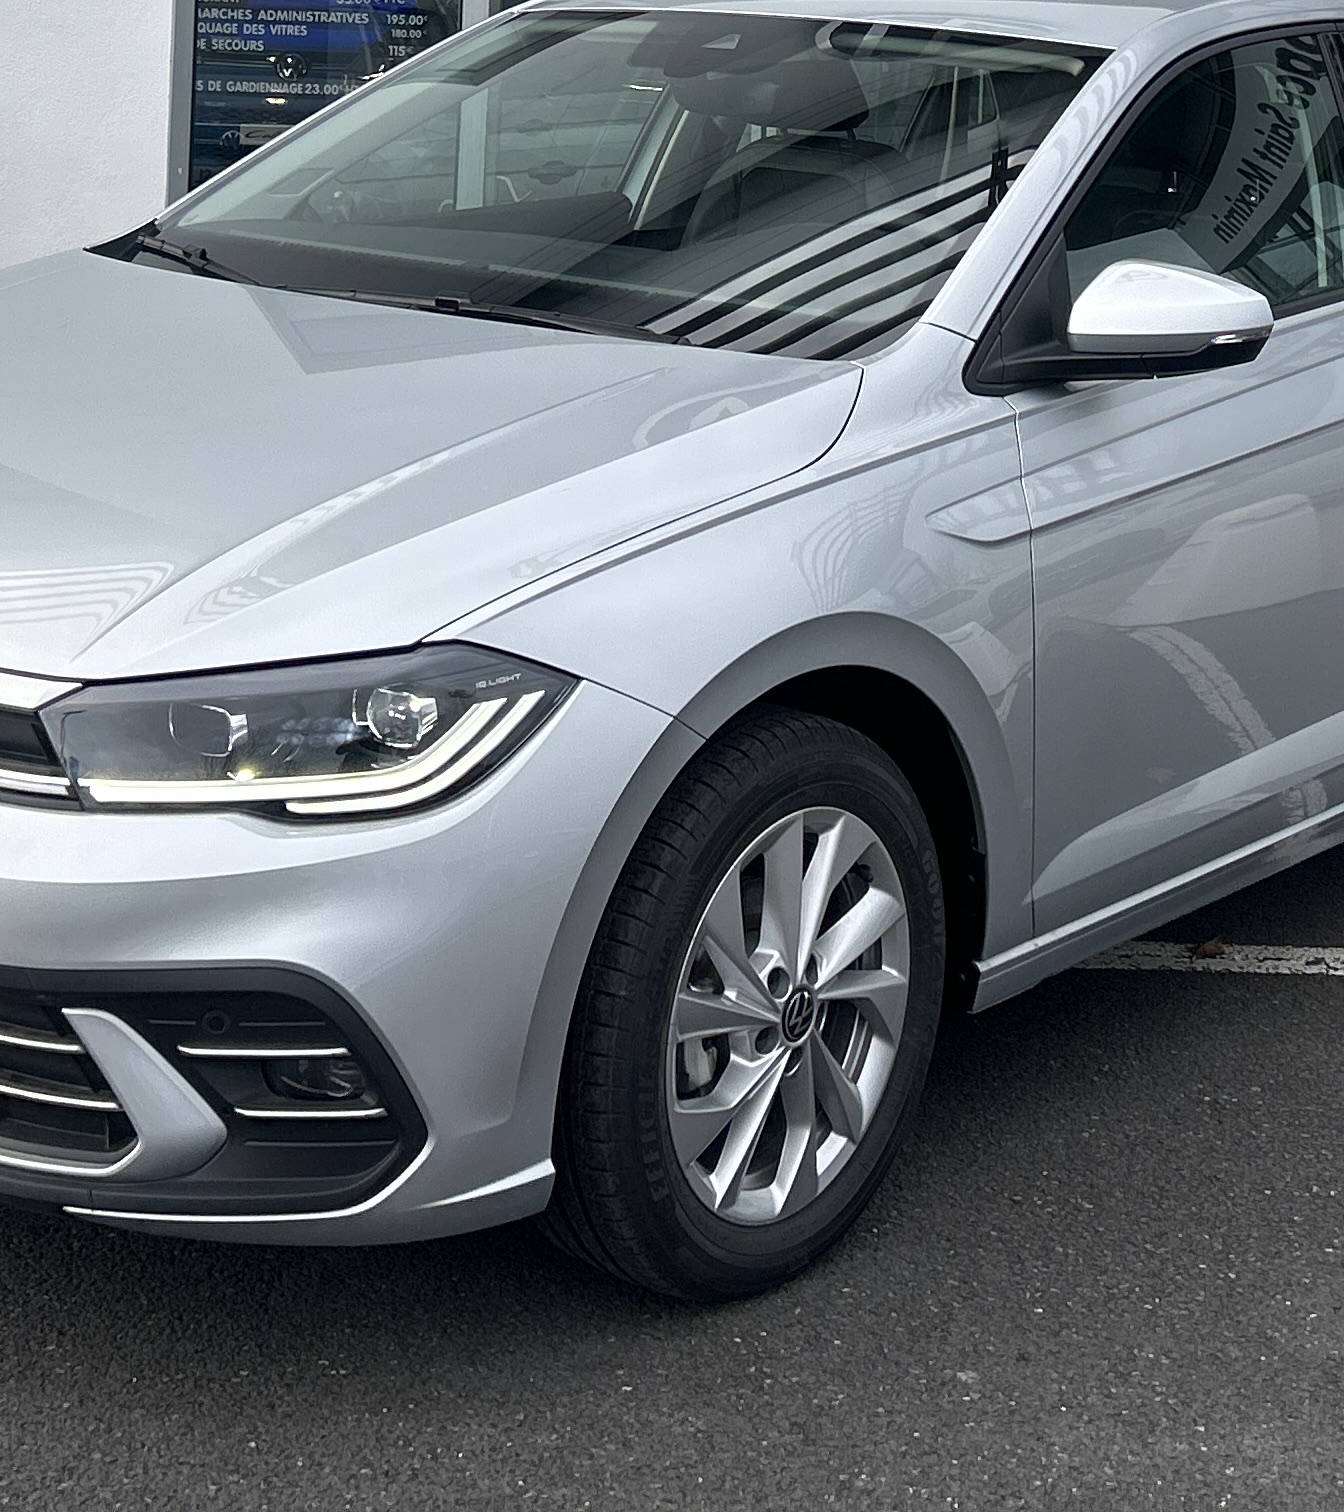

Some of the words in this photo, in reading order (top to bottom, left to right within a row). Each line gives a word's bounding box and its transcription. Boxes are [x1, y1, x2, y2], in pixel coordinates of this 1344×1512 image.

[258, 10, 369, 24] ADMINISTRATIVES
[197, 23, 238, 34] QUAGE
[243, 24, 265, 35] DES
[270, 24, 308, 36] VITRES
[211, 39, 265, 51] SECOURS
[208, 81, 222, 92] DE
[226, 81, 303, 94] GARDIENNAGE
